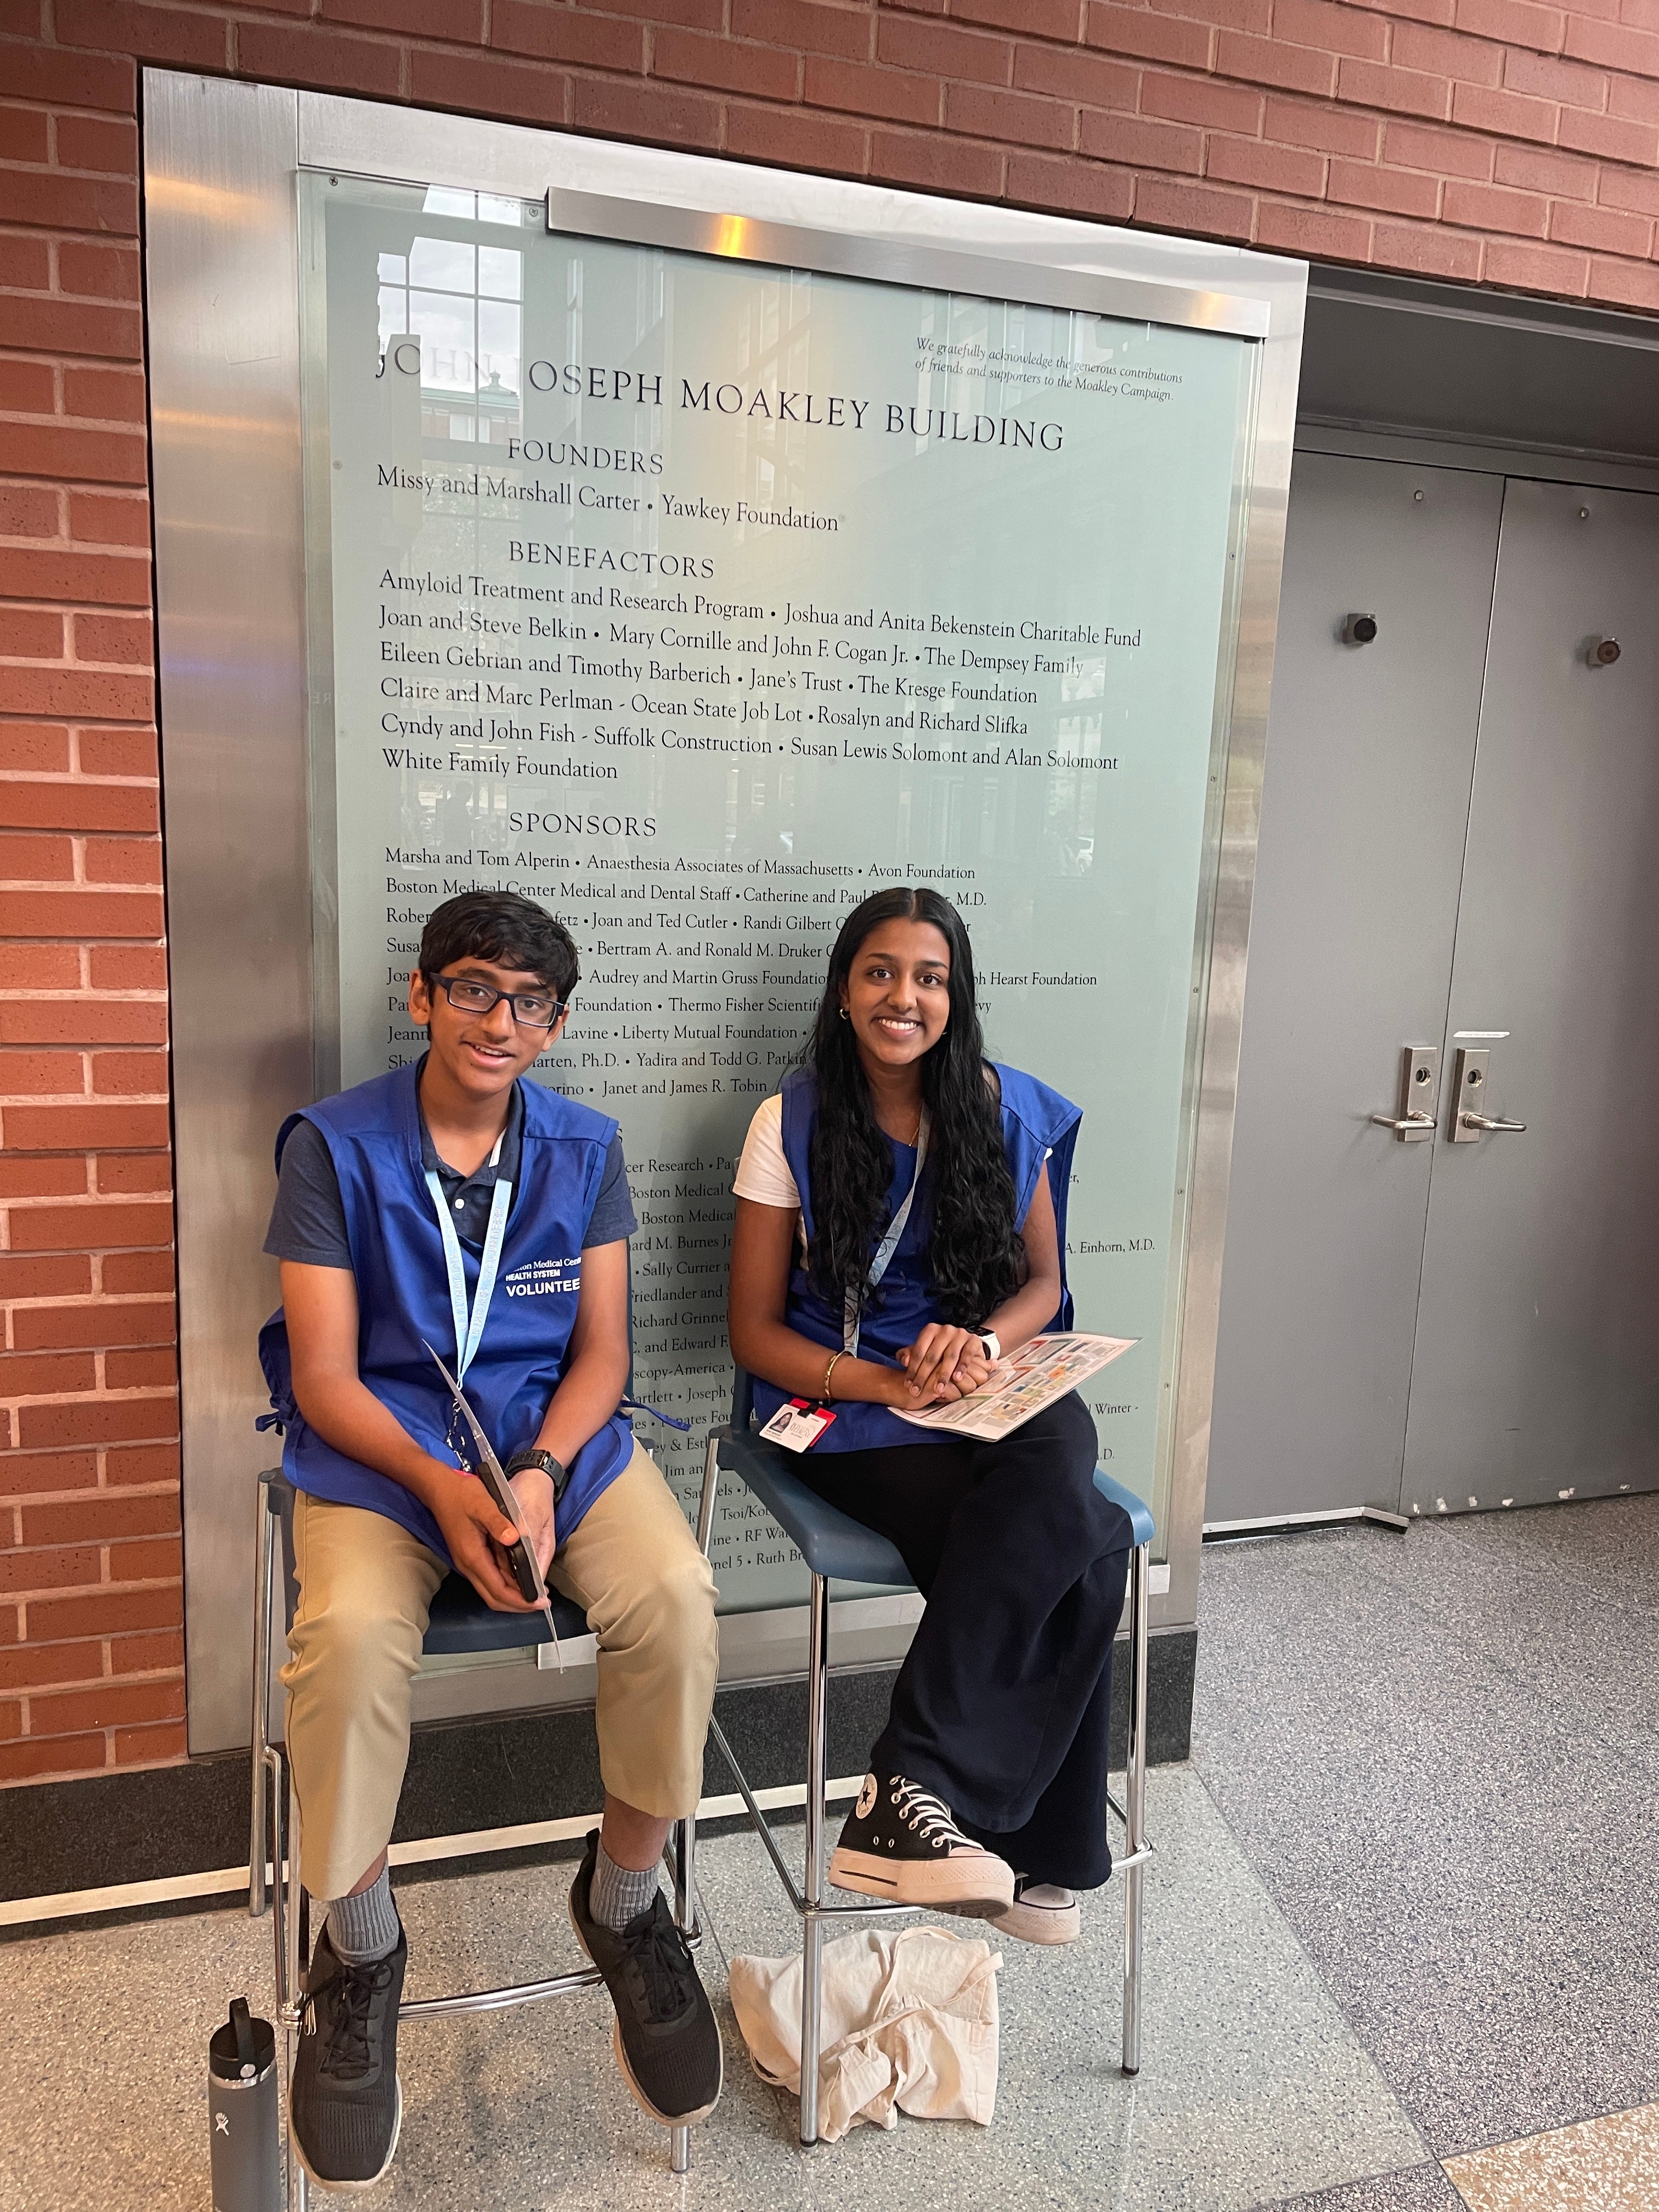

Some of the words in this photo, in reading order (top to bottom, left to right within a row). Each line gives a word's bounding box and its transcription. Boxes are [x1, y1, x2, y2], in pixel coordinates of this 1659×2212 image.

[917, 337, 934, 351] We
[936, 343, 985, 360] gratefully
[989, 349, 1053, 369] acknowledge
[1057, 356, 1070, 370] the
[1074, 362, 1117, 376] generous
[1120, 368, 1182, 383] contributions
[915, 357, 927, 371] of
[929, 359, 963, 375] friends
[967, 365, 986, 377] and
[989, 370, 1041, 384] supporters
[1045, 376, 1054, 385] to
[1058, 375, 1072, 387] the
[1075, 377, 1118, 396] Moakley
[1121, 383, 1173, 403] Campaign.
[681, 379, 870, 429] MOAKLEY
[885, 404, 1063, 451] BUILDING
[509, 438, 662, 475] FOUNDERS
[377, 465, 433, 495] Missy
[442, 475, 479, 496] and
[486, 476, 571, 505] Marshall
[579, 486, 640, 511] Carter
[662, 494, 730, 526] Yawkey
[737, 502, 838, 531] Foundation
[509, 541, 713, 578] BENEFACTORS
[379, 568, 462, 596] Amyloid
[469, 575, 565, 603] Treatment
[571, 586, 602, 606] and
[610, 588, 688, 613] Research
[695, 595, 764, 620] Program
[784, 603, 838, 625] Joshua
[844, 609, 873, 627] and
[878, 611, 924, 631] Anita
[931, 614, 1015, 637] Bekenstein
[1020, 621, 1099, 644] Charitable
[1104, 628, 1141, 646] Fund
[379, 605, 422, 629] Joan
[430, 610, 463, 630] and
[470, 613, 522, 635] Steve
[528, 617, 587, 640] Belkin
[610, 623, 654, 649] Mary
[661, 628, 731, 650] Cornille
[737, 634, 767, 653] and
[772, 636, 812, 658] John
[818, 639, 828, 657] F.
[836, 641, 887, 666] Cogan
[891, 645, 909, 667] Jr.
[924, 647, 955, 666] The
[961, 650, 1029, 675] Dempsey
[1034, 654, 1083, 678] Family
[380, 641, 440, 664] Eileen
[447, 646, 522, 670] Gebrian
[529, 653, 561, 673] and
[567, 655, 642, 683] Timothy
[649, 661, 731, 684] Barberich
[802, 672, 842, 691] Trust
[858, 676, 889, 695] The
[895, 678, 945, 702] Kresge
[951, 681, 1037, 703] Foundation
[382, 748, 442, 770] White
[449, 752, 510, 778] Family
[516, 755, 618, 778] Foundation
[510, 812, 656, 837] SPONSORS
[386, 847, 440, 865] Marsha
[445, 849, 472, 865] and
[477, 850, 510, 866] Tom
[515, 851, 569, 871] Alperin
[587, 854, 670, 871] Anaesthesia
[674, 857, 743, 873] Associates
[747, 859, 761, 873] of
[764, 860, 853, 876] Massachusetts
[868, 863, 902, 877] Avon
[906, 864, 975, 878] Foundation
[386, 878, 438, 894] Boston
[506, 881, 556, 896] Center
[560, 882, 616, 898] Medical
[621, 884, 645, 899] and
[651, 885, 695, 900] Dental
[700, 885, 732, 901] Staff
[743, 889, 809, 904] Catherine
[812, 889, 835, 903] and
[840, 889, 866, 904] Paul
[957, 892, 986, 905] M.D.
[591, 912, 623, 929] Joan
[628, 913, 652, 927] and
[656, 913, 681, 928] Ted
[686, 914, 728, 928] Cutler
[743, 915, 781, 929] Randi
[786, 916, 831, 930] Gilbert
[597, 941, 651, 955] Bertram
[656, 942, 672, 956] A.
[677, 941, 701, 956] and
[706, 943, 752, 956] Ronald
[757, 943, 773, 957] M.
[778, 943, 822, 957] Druker
[589, 969, 639, 986] Audrey
[644, 969, 667, 984] and
[673, 970, 718, 984] Martin
[722, 970, 758, 984] Gruss
[990, 972, 1028, 985] Hearst
[1032, 972, 1097, 985] Foundation
[575, 997, 652, 1011] Foundation
[668, 997, 721, 1011] Thermo
[726, 997, 764, 1011] Fisher
[562, 1026, 609, 1040] Lavine
[623, 1025, 669, 1042] Liberty
[674, 1025, 720, 1039] Mutual
[725, 1024, 797, 1039] Foundation
[582, 1053, 619, 1067] Ph.D.
[636, 1052, 677, 1066] Yadira
[682, 1052, 705, 1066] and
[709, 1051, 742, 1065] Todd
[747, 1052, 761, 1065] G.
[767, 1051, 806, 1065] Patkin
[602, 1081, 637, 1097] Janet
[642, 1079, 665, 1093] and
[669, 1080, 707, 1096] James
[712, 1079, 725, 1092] R.
[730, 1078, 767, 1092] Tobin
[648, 1158, 703, 1172] Research
[629, 1186, 670, 1199] Boston
[675, 1183, 724, 1198] Medical
[642, 1211, 684, 1224] Boston
[689, 1209, 736, 1222] Medical
[656, 1237, 672, 1249] M.
[678, 1235, 719, 1249] Burnes
[1080, 1241, 1125, 1254] Einhorn,
[1129, 1239, 1155, 1251] M.D.
[533, 1259, 563, 1269] Medical
[642, 1262, 672, 1278] Sally
[676, 1261, 720, 1274] Currier
[506, 1272, 532, 1282] HEALTH
[533, 1269, 561, 1279] SYSTEM
[506, 1278, 580, 1297] VOLUNTEE
[701, 1285, 723, 1298] and
[632, 1313, 677, 1328] Richard
[645, 1339, 667, 1353] and
[672, 1335, 715, 1351] Edward
[687, 1385, 726, 1403] Joseph
[1096, 1403, 1131, 1414] Winter
[664, 1465, 685, 1480] Jim
[745, 1530, 761, 1542] RF
[737, 1555, 743, 1567] 5
[757, 1553, 785, 1566] Ruth
